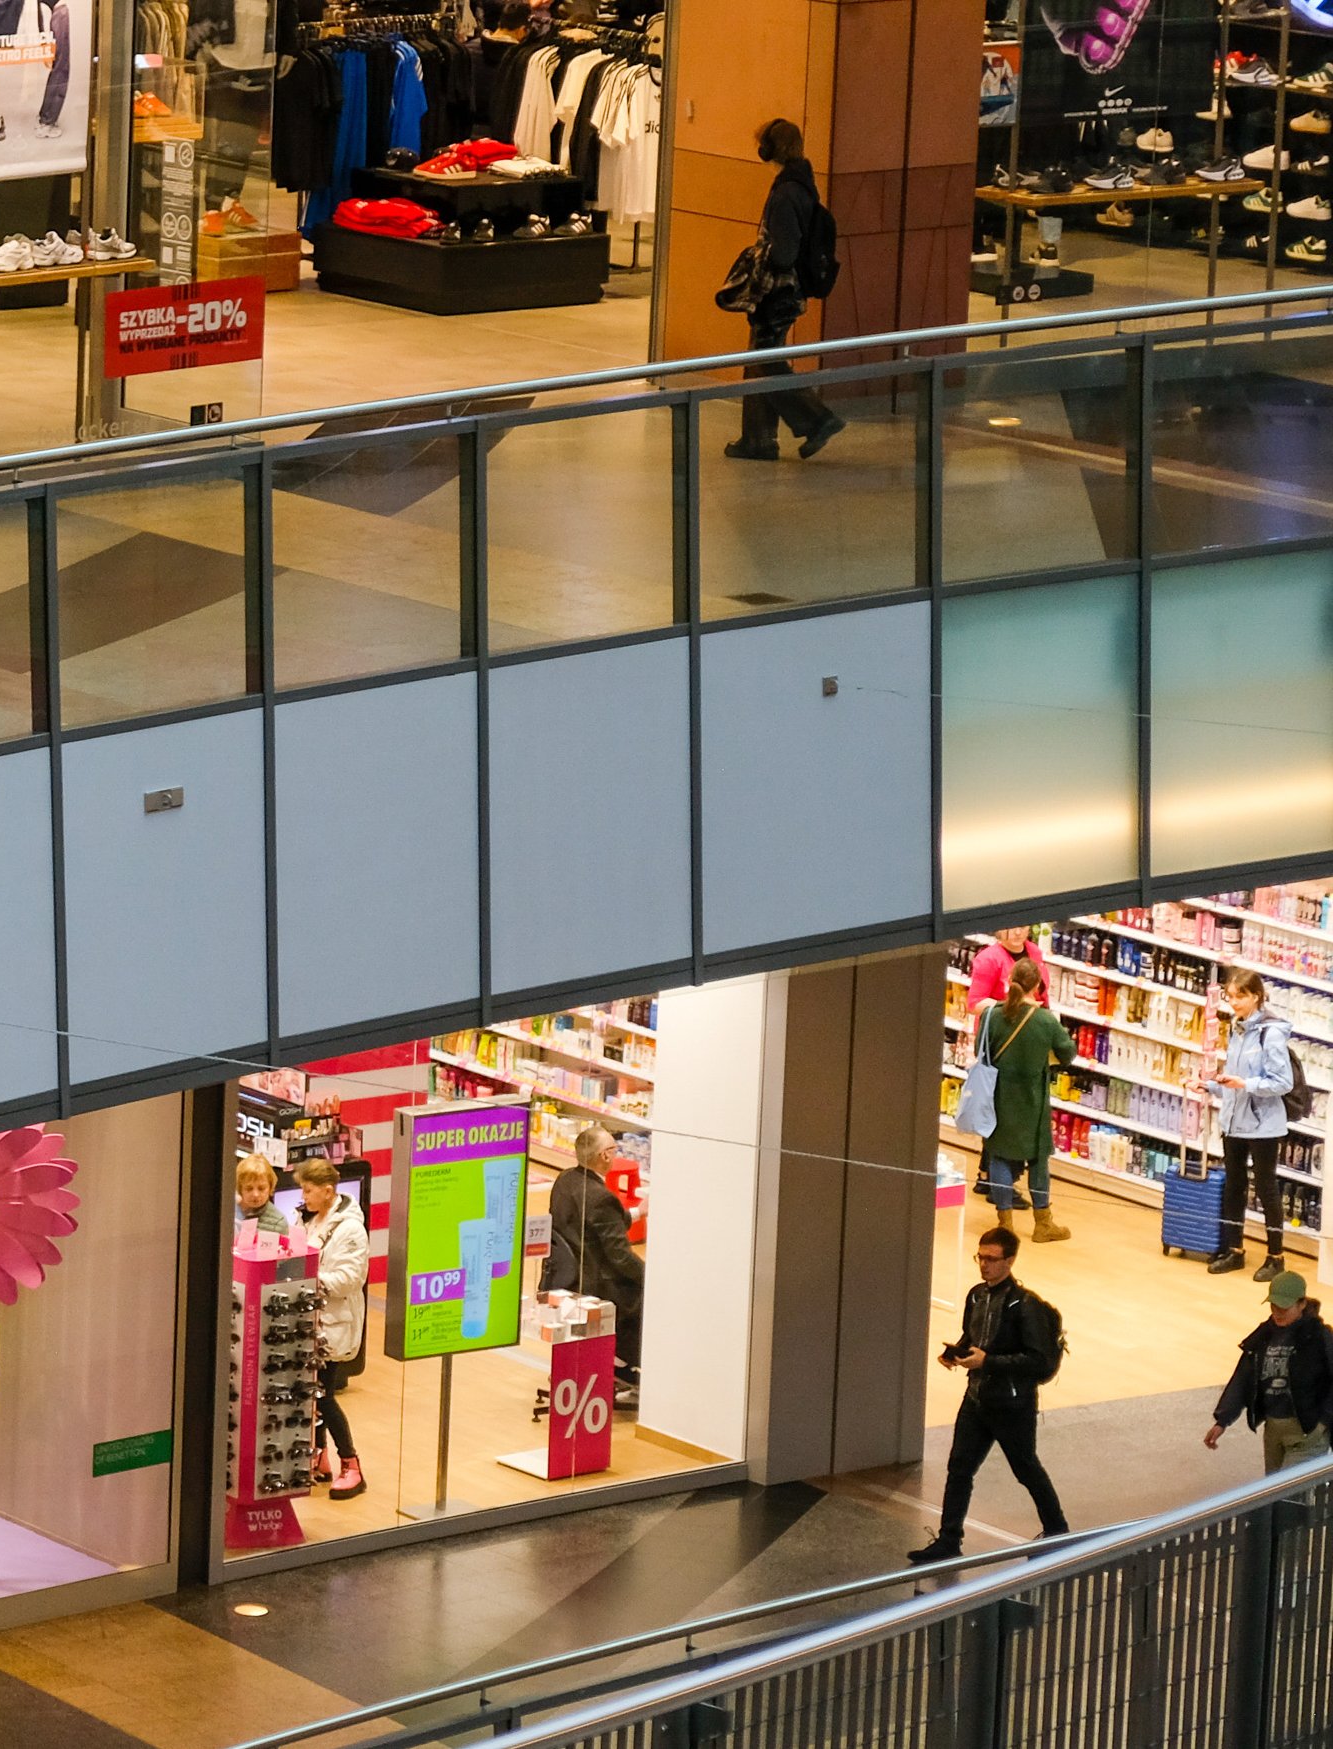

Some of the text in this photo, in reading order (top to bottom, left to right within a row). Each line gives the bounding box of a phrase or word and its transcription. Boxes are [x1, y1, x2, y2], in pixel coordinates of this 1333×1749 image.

[119, 306, 176, 329] SZYBKA
[176, 298, 247, 334] -20%
[119, 325, 176, 342] WYPRZEDAŻ
[136, 335, 185, 352] WYBRANE
[278, 1107, 302, 1117] GOSH
[416, 1120, 525, 1152] SUPER OKAZJE
[244, 1304, 257, 1406] FASHION EYEWEAR
[554, 1373, 609, 1439] %
[247, 1509, 283, 1522] TYLKO
